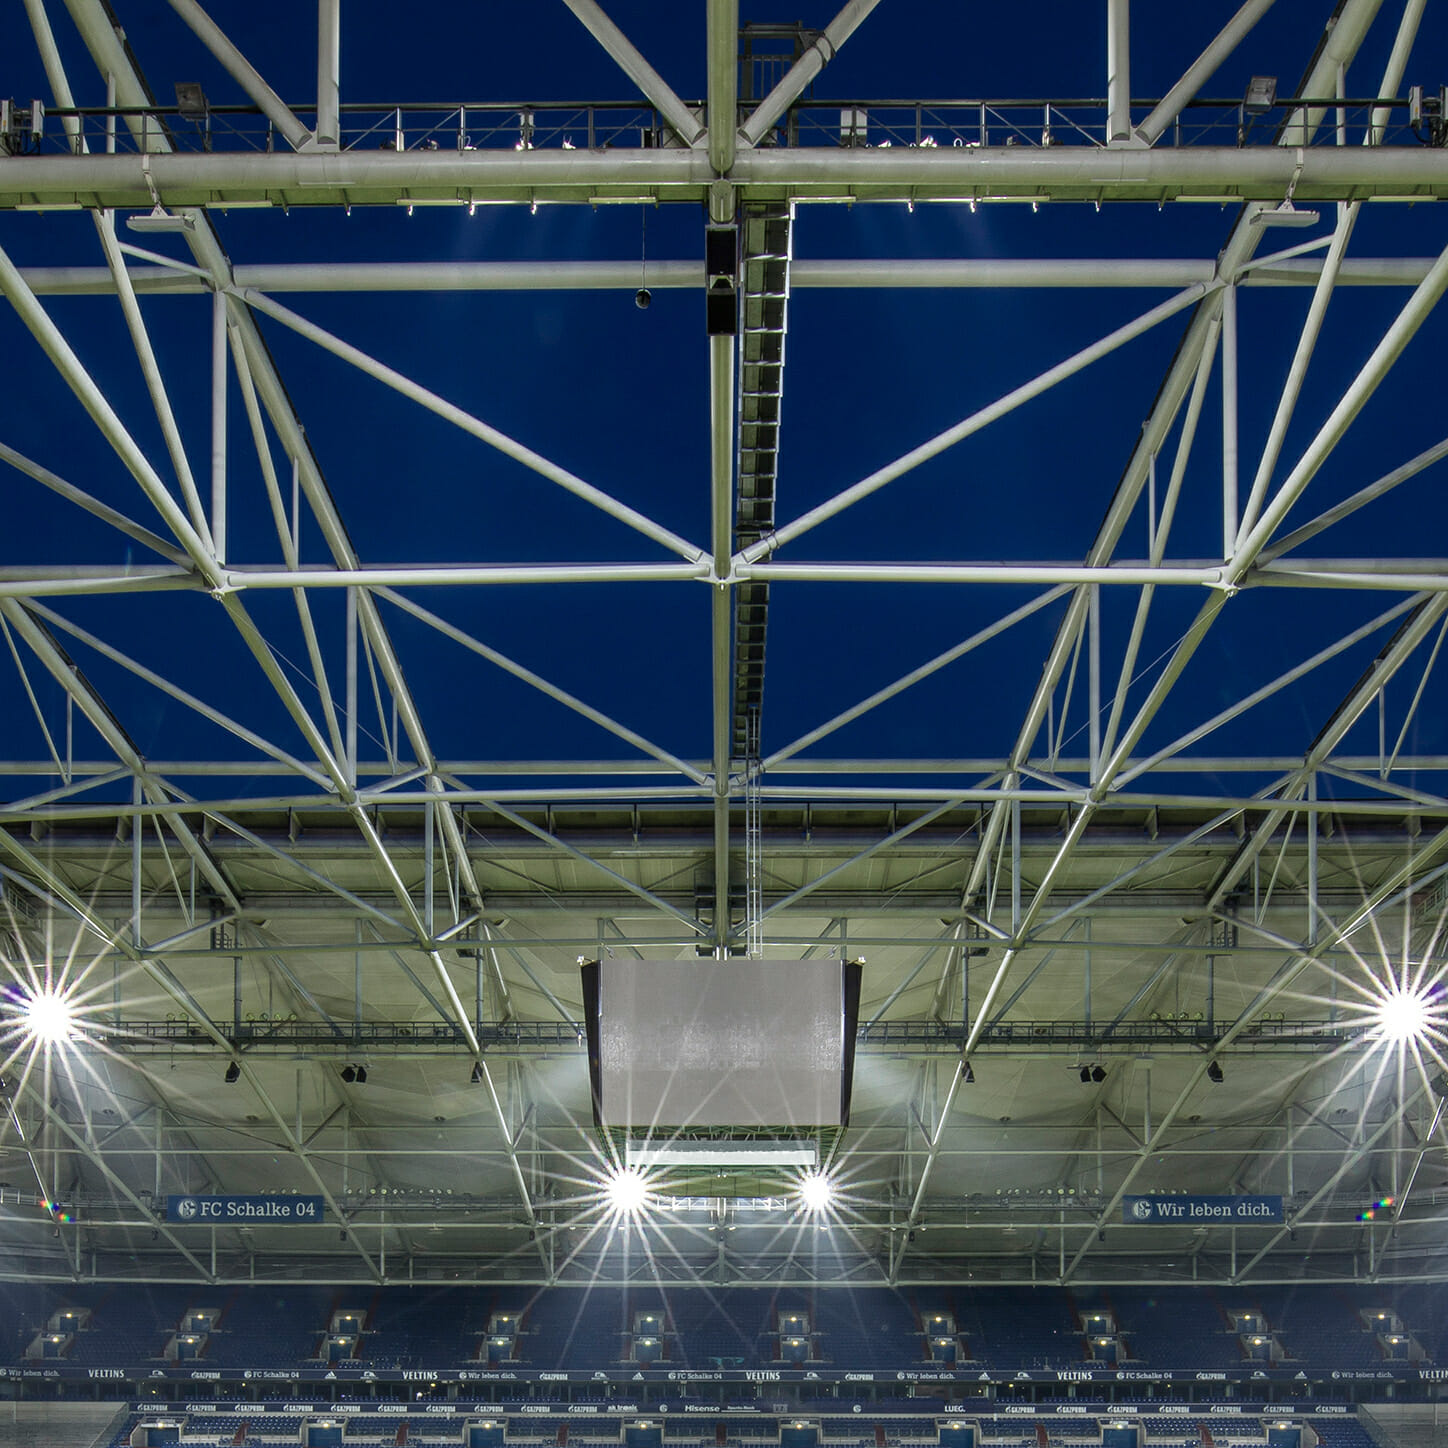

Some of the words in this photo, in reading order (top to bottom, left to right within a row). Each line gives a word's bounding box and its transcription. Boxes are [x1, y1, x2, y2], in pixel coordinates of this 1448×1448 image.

[200, 1204, 222, 1217] FC
[227, 1203, 290, 1217] Schalke
[296, 1203, 315, 1217] 04
[1156, 1204, 1184, 1217] Wir
[1190, 1203, 1232, 1217] leben
[1237, 1203, 1275, 1216] dich.
[23, 1368, 43, 1377] leben
[44, 1369, 60, 1378] dich.
[88, 1369, 125, 1379] VELTINS
[263, 1371, 289, 1380] Schalke
[402, 1371, 438, 1381] VELTINS
[468, 1372, 480, 1380] Wir
[481, 1371, 501, 1380] leben
[502, 1371, 517, 1380] dich.
[677, 1372, 687, 1380] FC
[688, 1372, 712, 1380] Schalke
[713, 1372, 723, 1380] 04
[745, 1371, 781, 1381] VELTINS
[906, 1372, 919, 1380] Wir
[920, 1372, 939, 1380] leben
[940, 1372, 956, 1380] dich.
[1057, 1371, 1093, 1381] VELTINS
[1125, 1372, 1135, 1380] FC
[1136, 1372, 1163, 1380] Schalke
[1164, 1372, 1173, 1380] 04
[1341, 1371, 1354, 1379] Wir
[1355, 1371, 1374, 1379] leben
[1376, 1371, 1394, 1379] dich.
[685, 1404, 720, 1412] Hisense
[944, 1404, 966, 1412] LUEG.
